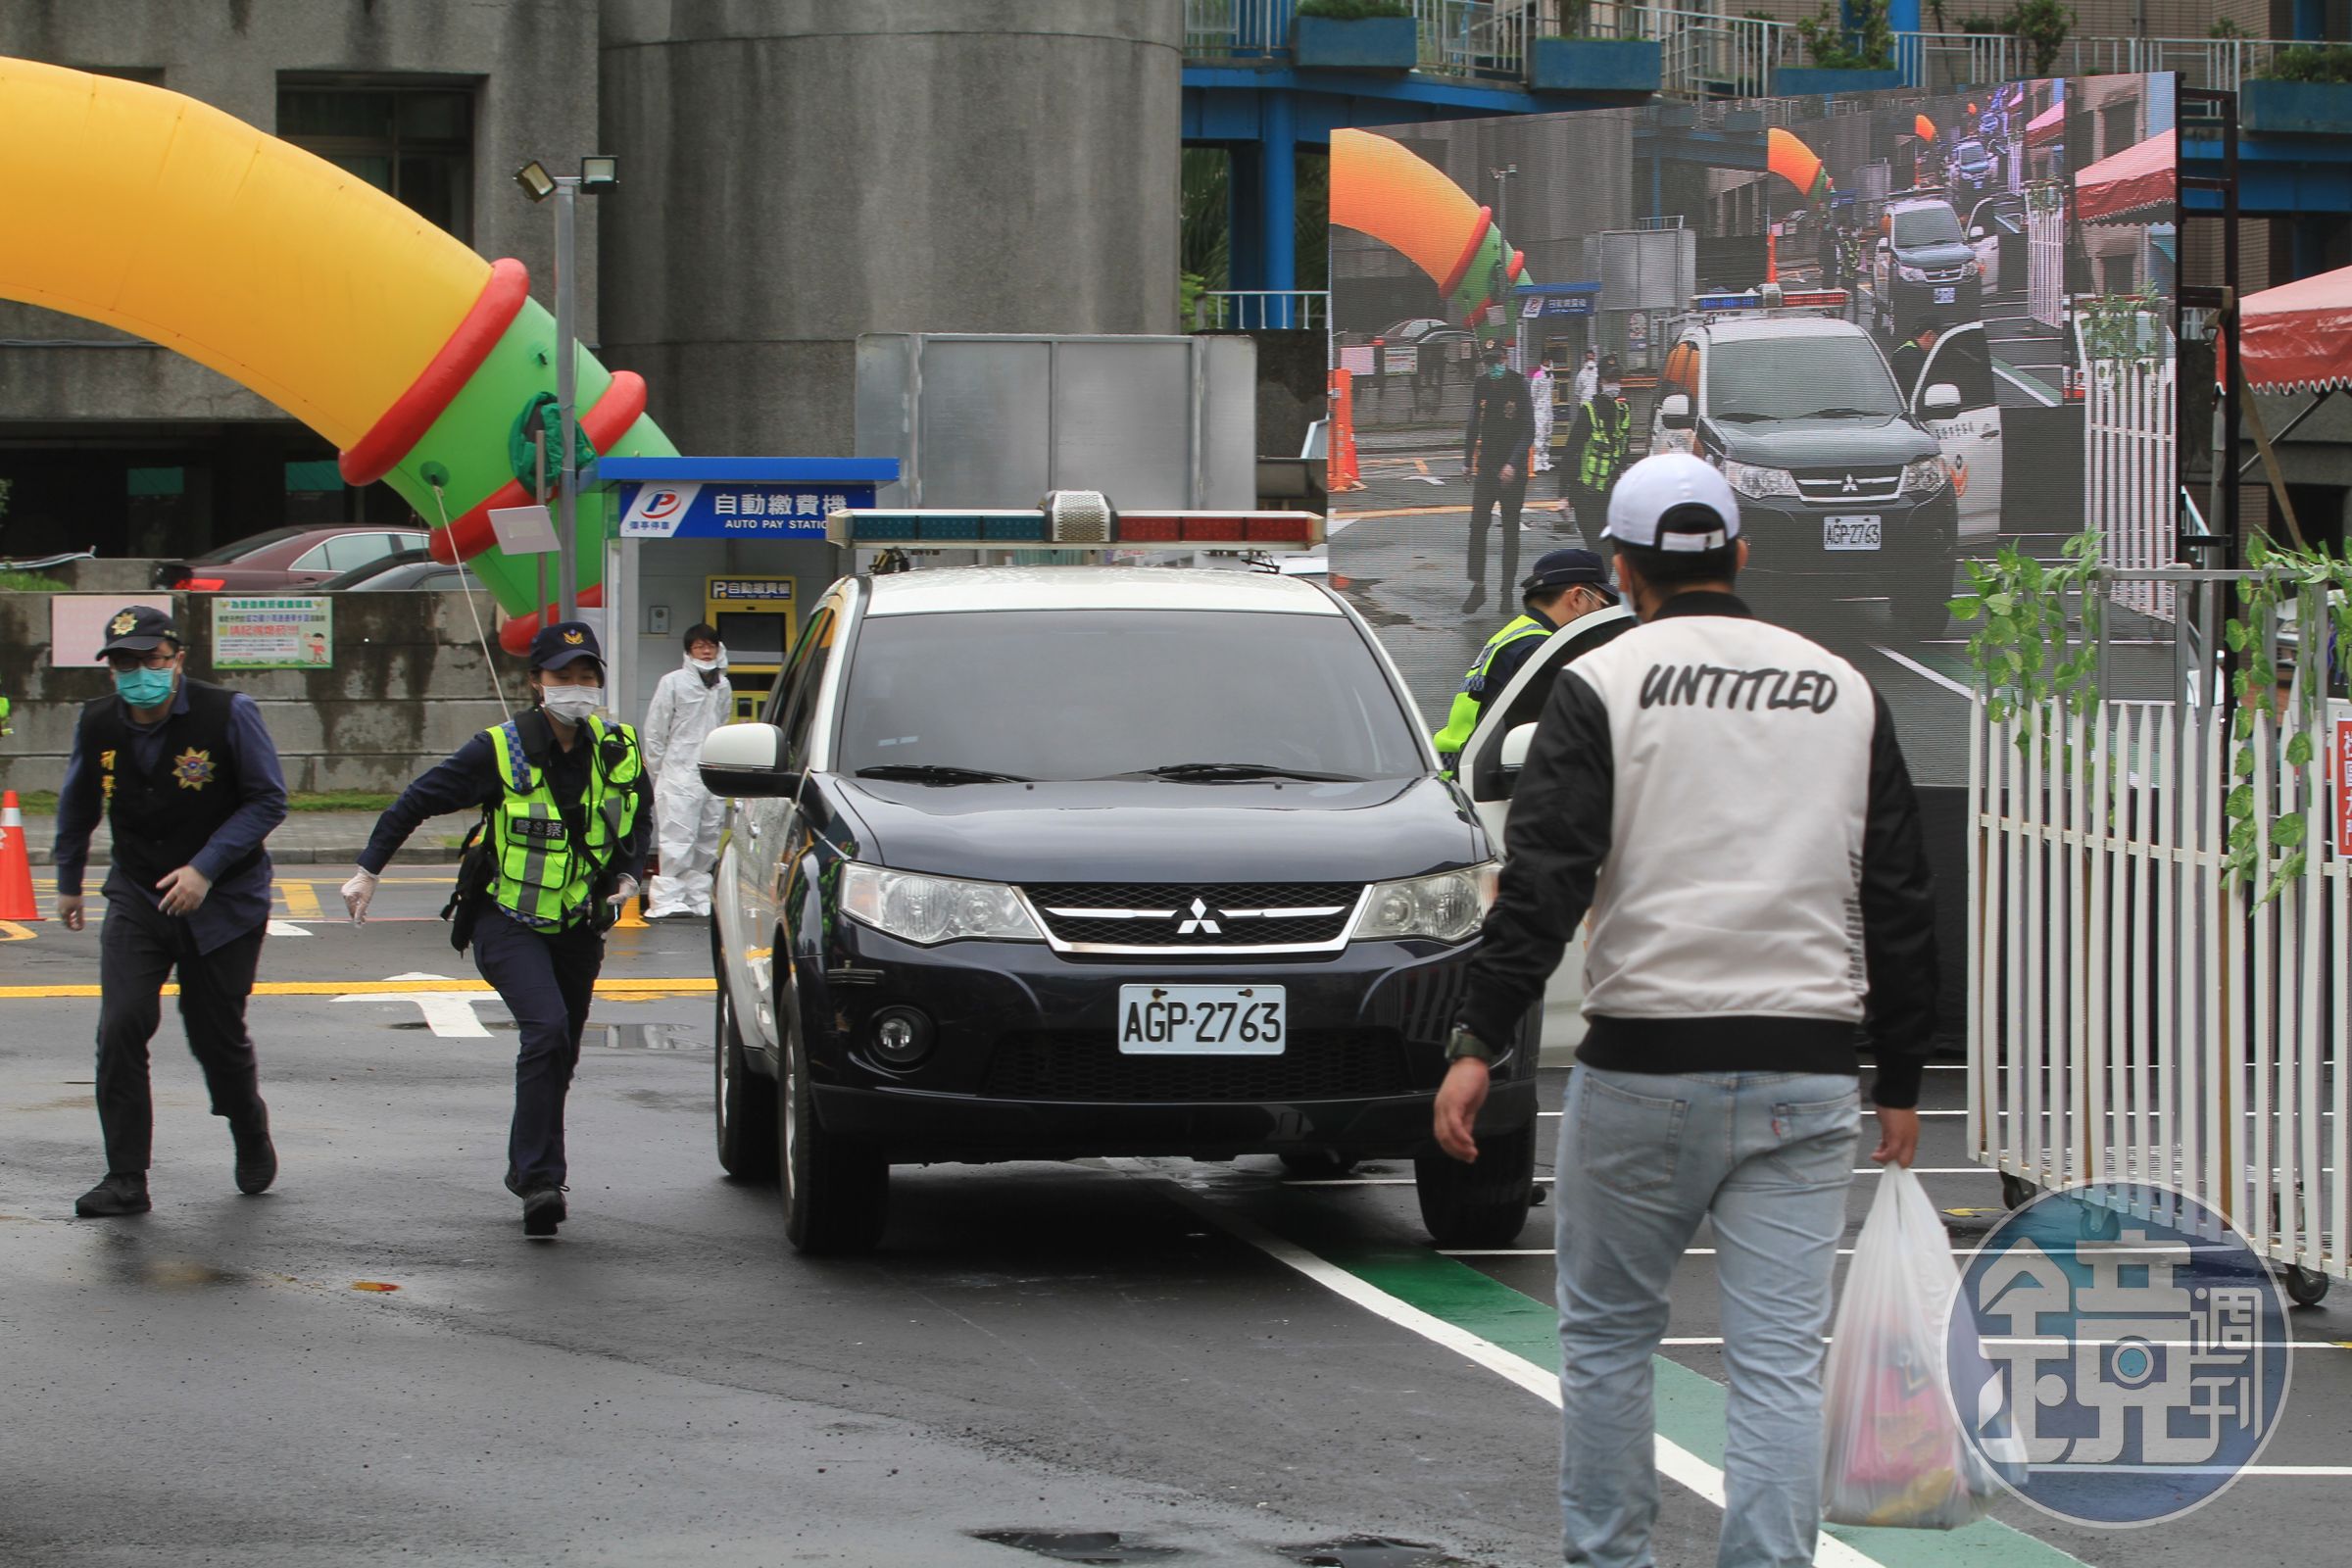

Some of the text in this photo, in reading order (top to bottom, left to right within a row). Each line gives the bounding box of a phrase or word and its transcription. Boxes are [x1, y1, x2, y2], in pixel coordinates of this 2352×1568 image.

[714, 493, 848, 516] 自動繳費機
[724, 519, 828, 529] AUTO PAY STATIO
[1826, 524, 1881, 545] AGP-2763
[1639, 663, 1838, 714] UNTITLED
[1123, 1002, 1282, 1043] AGP-2763
